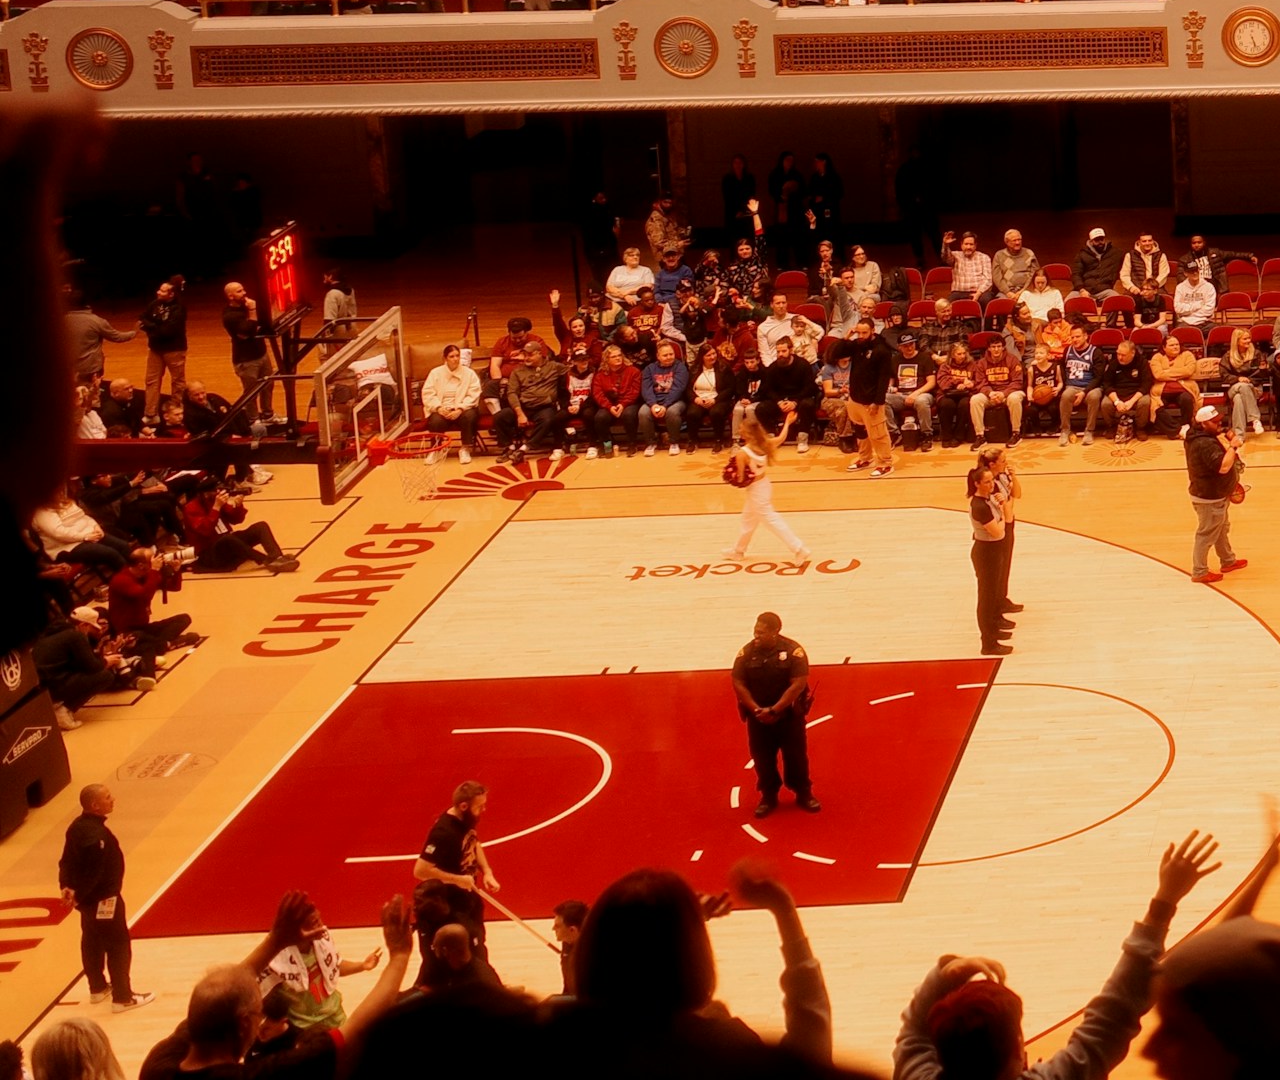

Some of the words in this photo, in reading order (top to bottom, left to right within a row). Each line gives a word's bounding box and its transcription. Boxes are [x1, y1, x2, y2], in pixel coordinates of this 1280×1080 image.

[269, 235, 294, 270] 2:59
[275, 264, 296, 312] 14
[1068, 368, 1084, 380] 24
[625, 560, 812, 581] Rocket
[242, 520, 457, 658] CHARGE
[13, 730, 43, 757] SERVPRO
